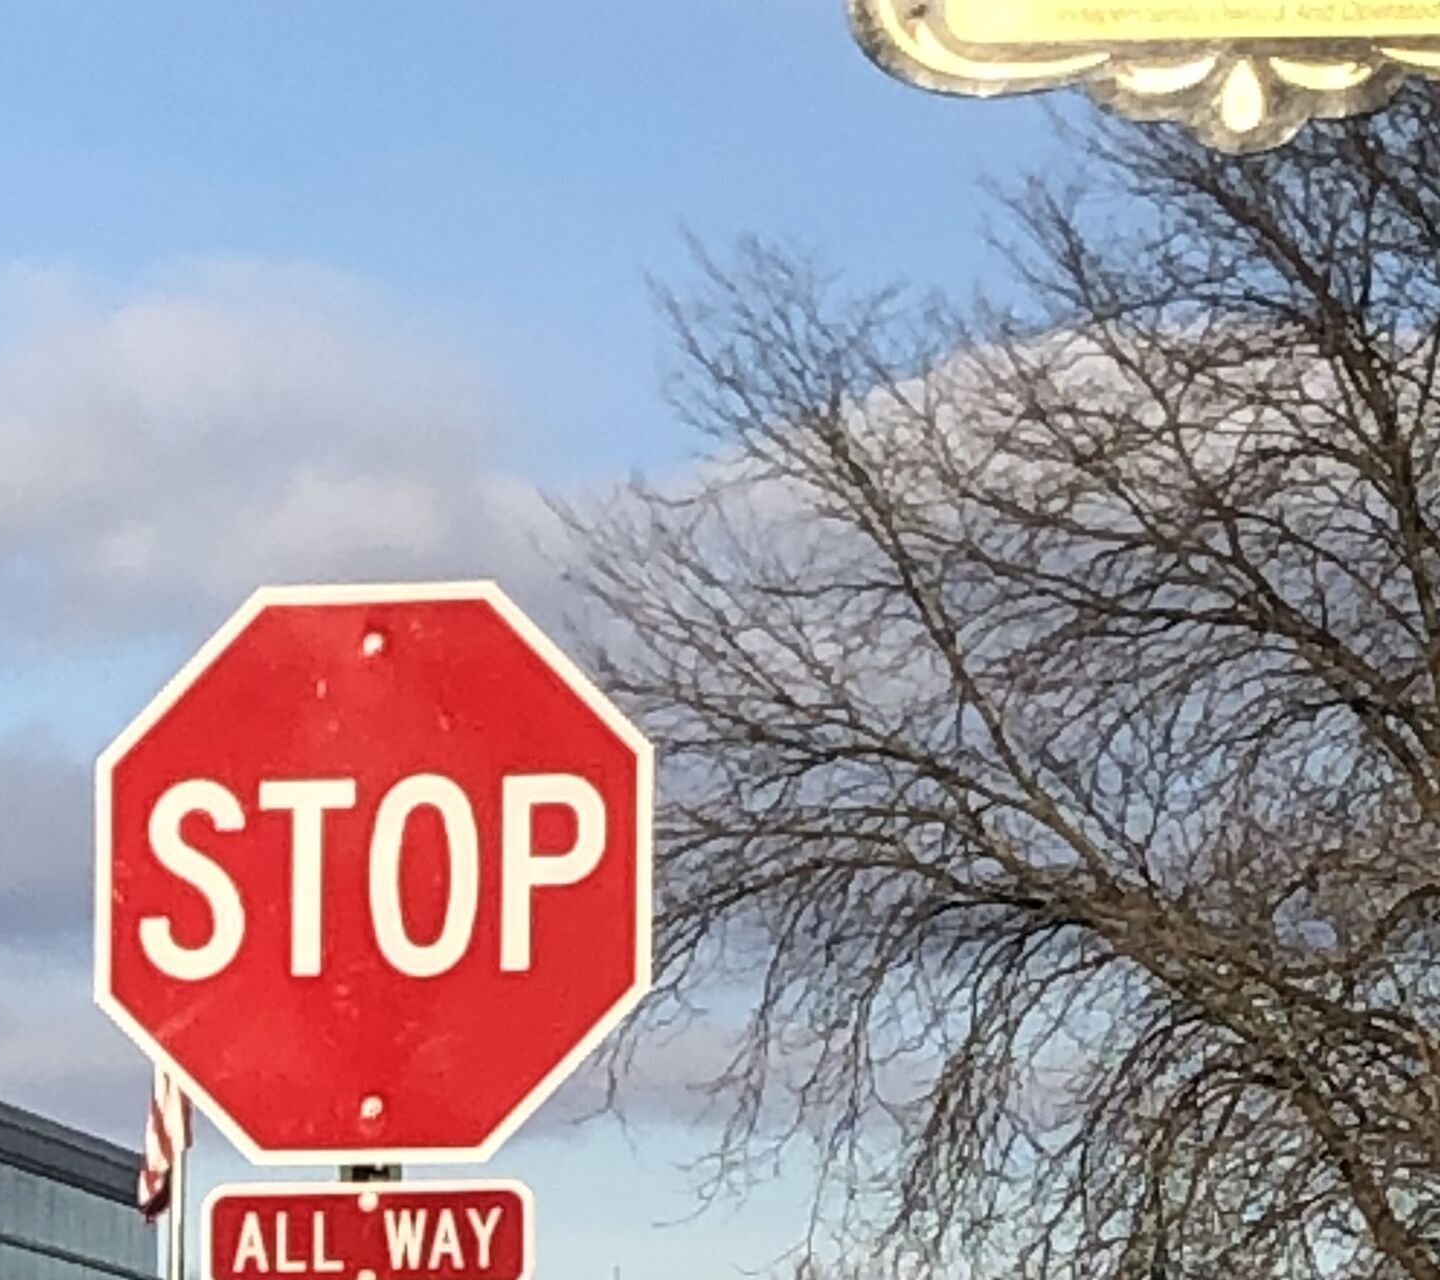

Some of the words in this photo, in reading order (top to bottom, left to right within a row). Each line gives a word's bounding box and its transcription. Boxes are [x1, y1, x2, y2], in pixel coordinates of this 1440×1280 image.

[139, 772, 607, 981] STOP
[232, 1210, 345, 1274] ALL
[383, 1206, 504, 1272] WAY
